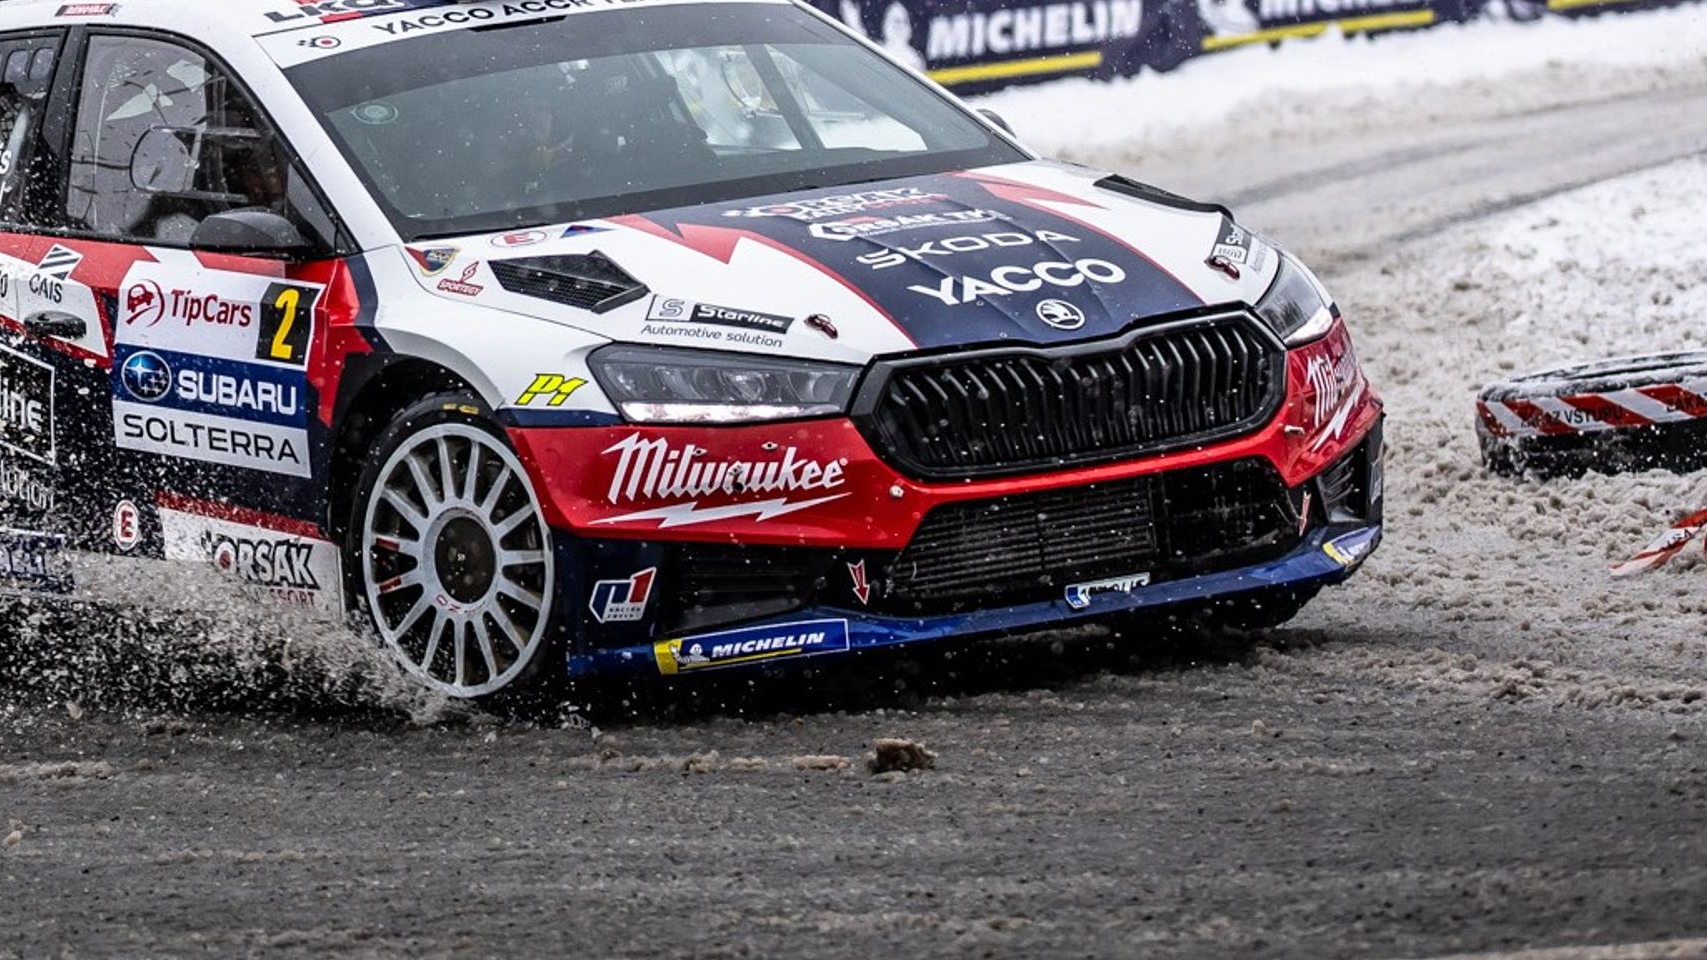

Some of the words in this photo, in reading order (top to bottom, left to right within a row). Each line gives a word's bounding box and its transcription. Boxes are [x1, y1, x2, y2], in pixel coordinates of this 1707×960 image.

[373, 8, 494, 35] YACCO
[29, 273, 63, 303] CAIS
[906, 258, 1126, 306] YACCO
[170, 290, 251, 327] TipCars
[270, 288, 300, 360] 2
[698, 304, 785, 328] Starline
[641, 324, 722, 340] Automotive
[725, 332, 782, 348] solution
[178, 370, 296, 415] SUBARU
[514, 373, 588, 406] P1
[124, 413, 300, 464] SOLTERRA
[601, 431, 847, 505] Milwaukee
[121, 511, 135, 539] E
[712, 631, 826, 658] MICHELIN
